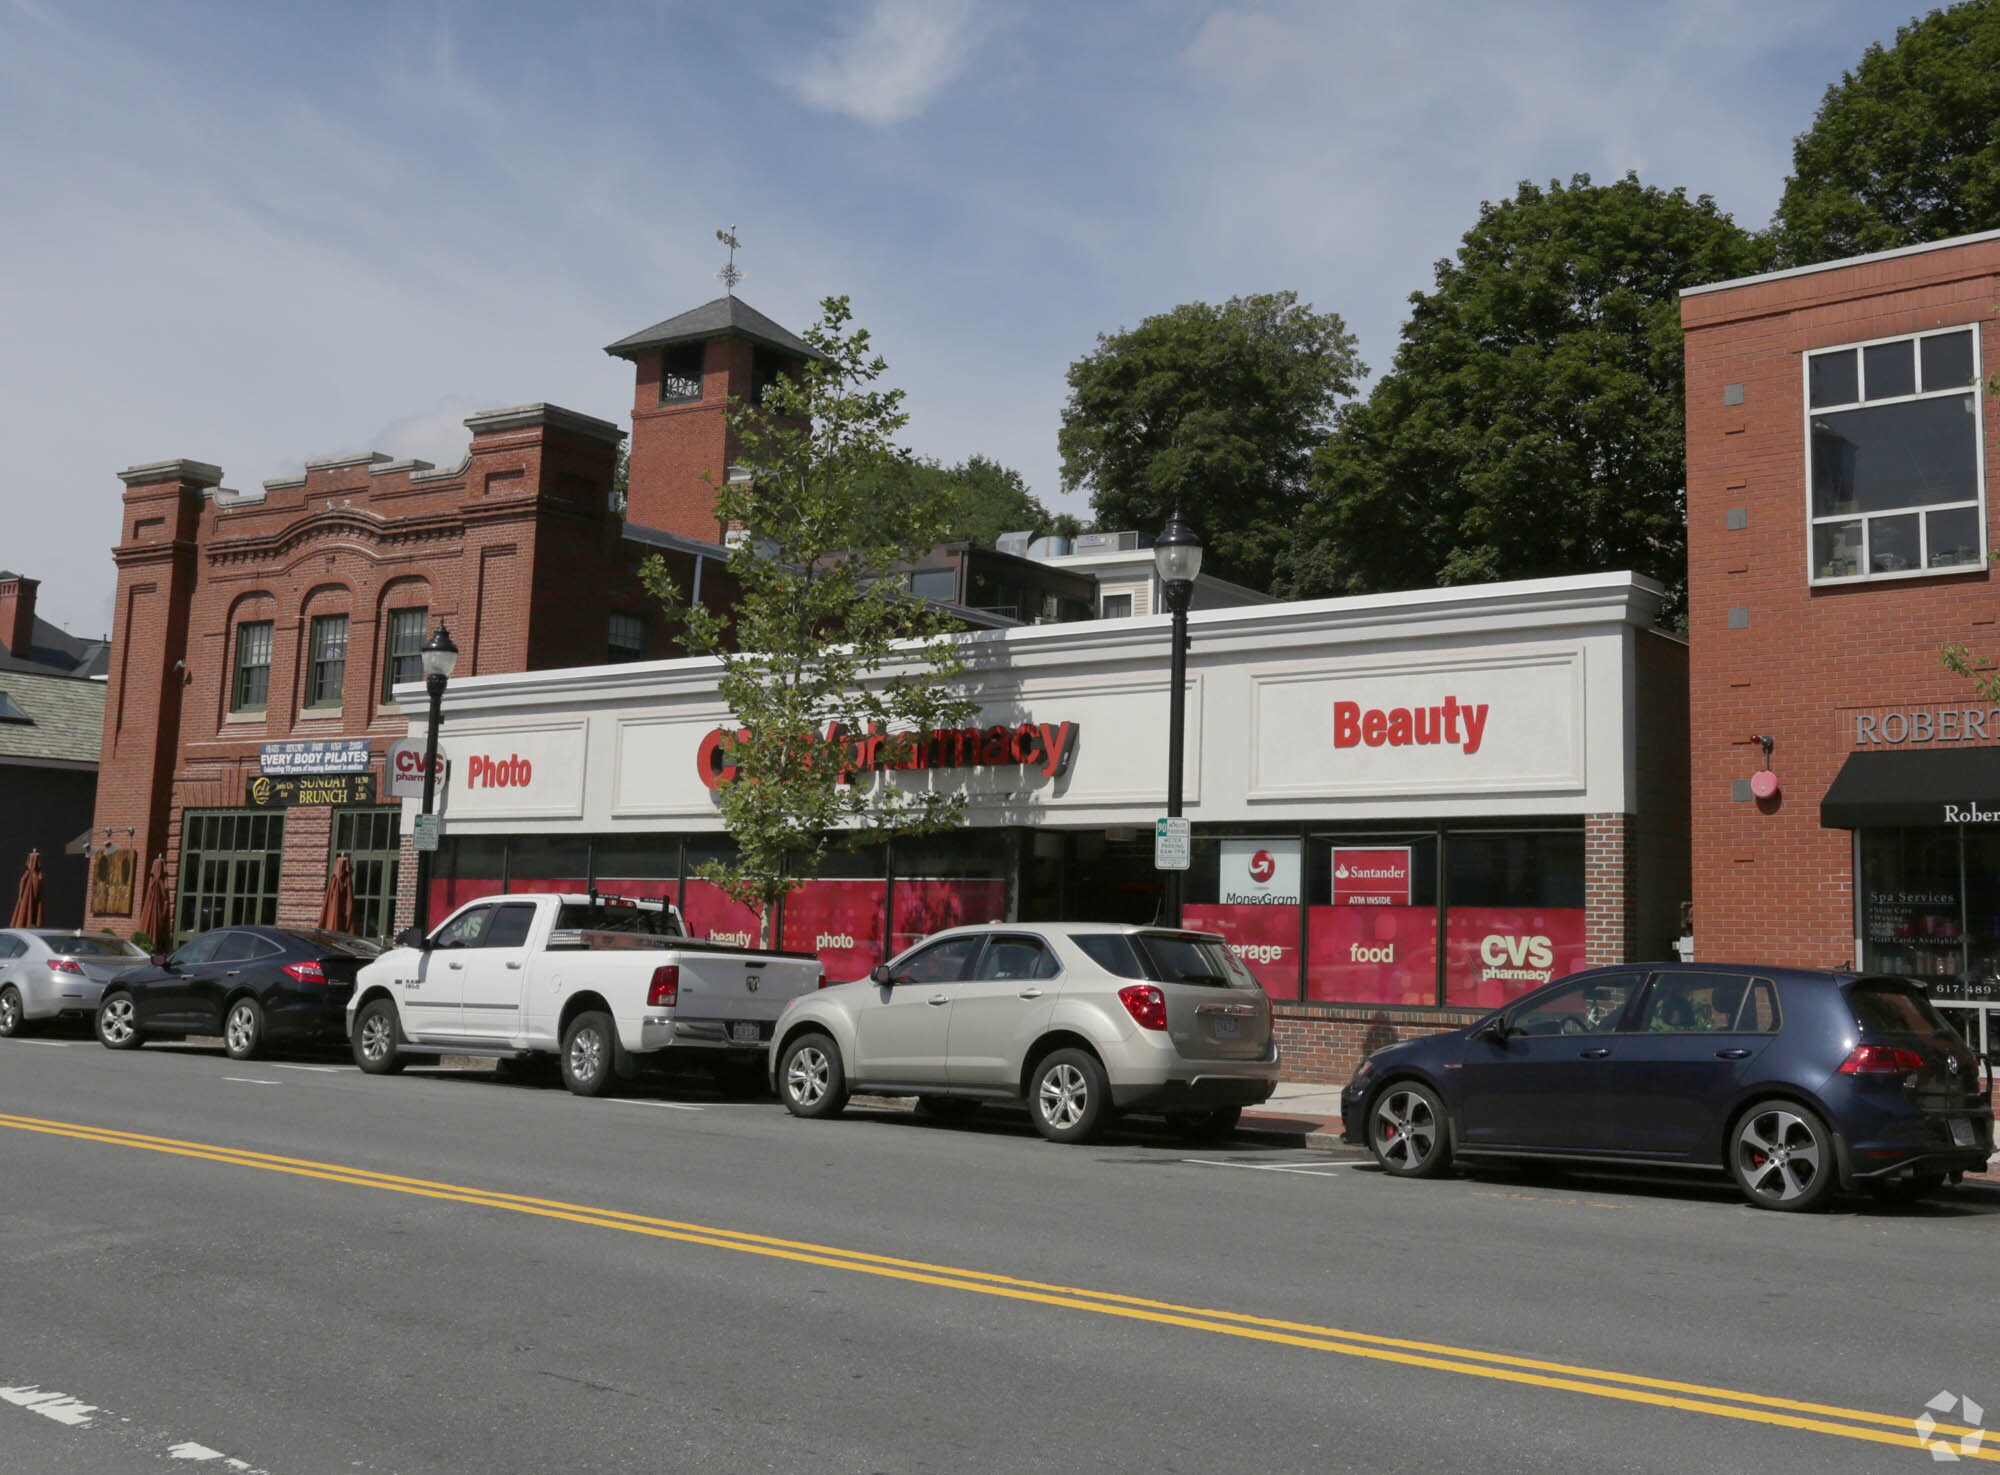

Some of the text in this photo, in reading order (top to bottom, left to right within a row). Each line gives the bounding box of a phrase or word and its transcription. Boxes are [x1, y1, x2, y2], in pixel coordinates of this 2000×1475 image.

[1333, 696, 1489, 754] Beauty
[260, 751, 368, 766] EVERY BODY PILATES
[395, 750, 444, 774] CVS
[396, 772, 443, 784] pharmcy
[468, 753, 532, 789] Photo
[300, 775, 348, 788] SUNDAY
[299, 789, 348, 804] BRUNCH
[1944, 801, 2000, 823] Rober
[1351, 866, 1406, 879] Santander
[1226, 892, 1297, 904] MoneyGram
[1349, 895, 1391, 905] ATM INSIDE
[1871, 891, 1955, 905] Spa Services
[710, 929, 751, 948] beauty
[816, 931, 854, 951] photo
[1228, 944, 1282, 964] erage
[1350, 943, 1393, 963] food
[1481, 935, 1553, 968] CVS
[1482, 966, 1551, 983] pharmacy
